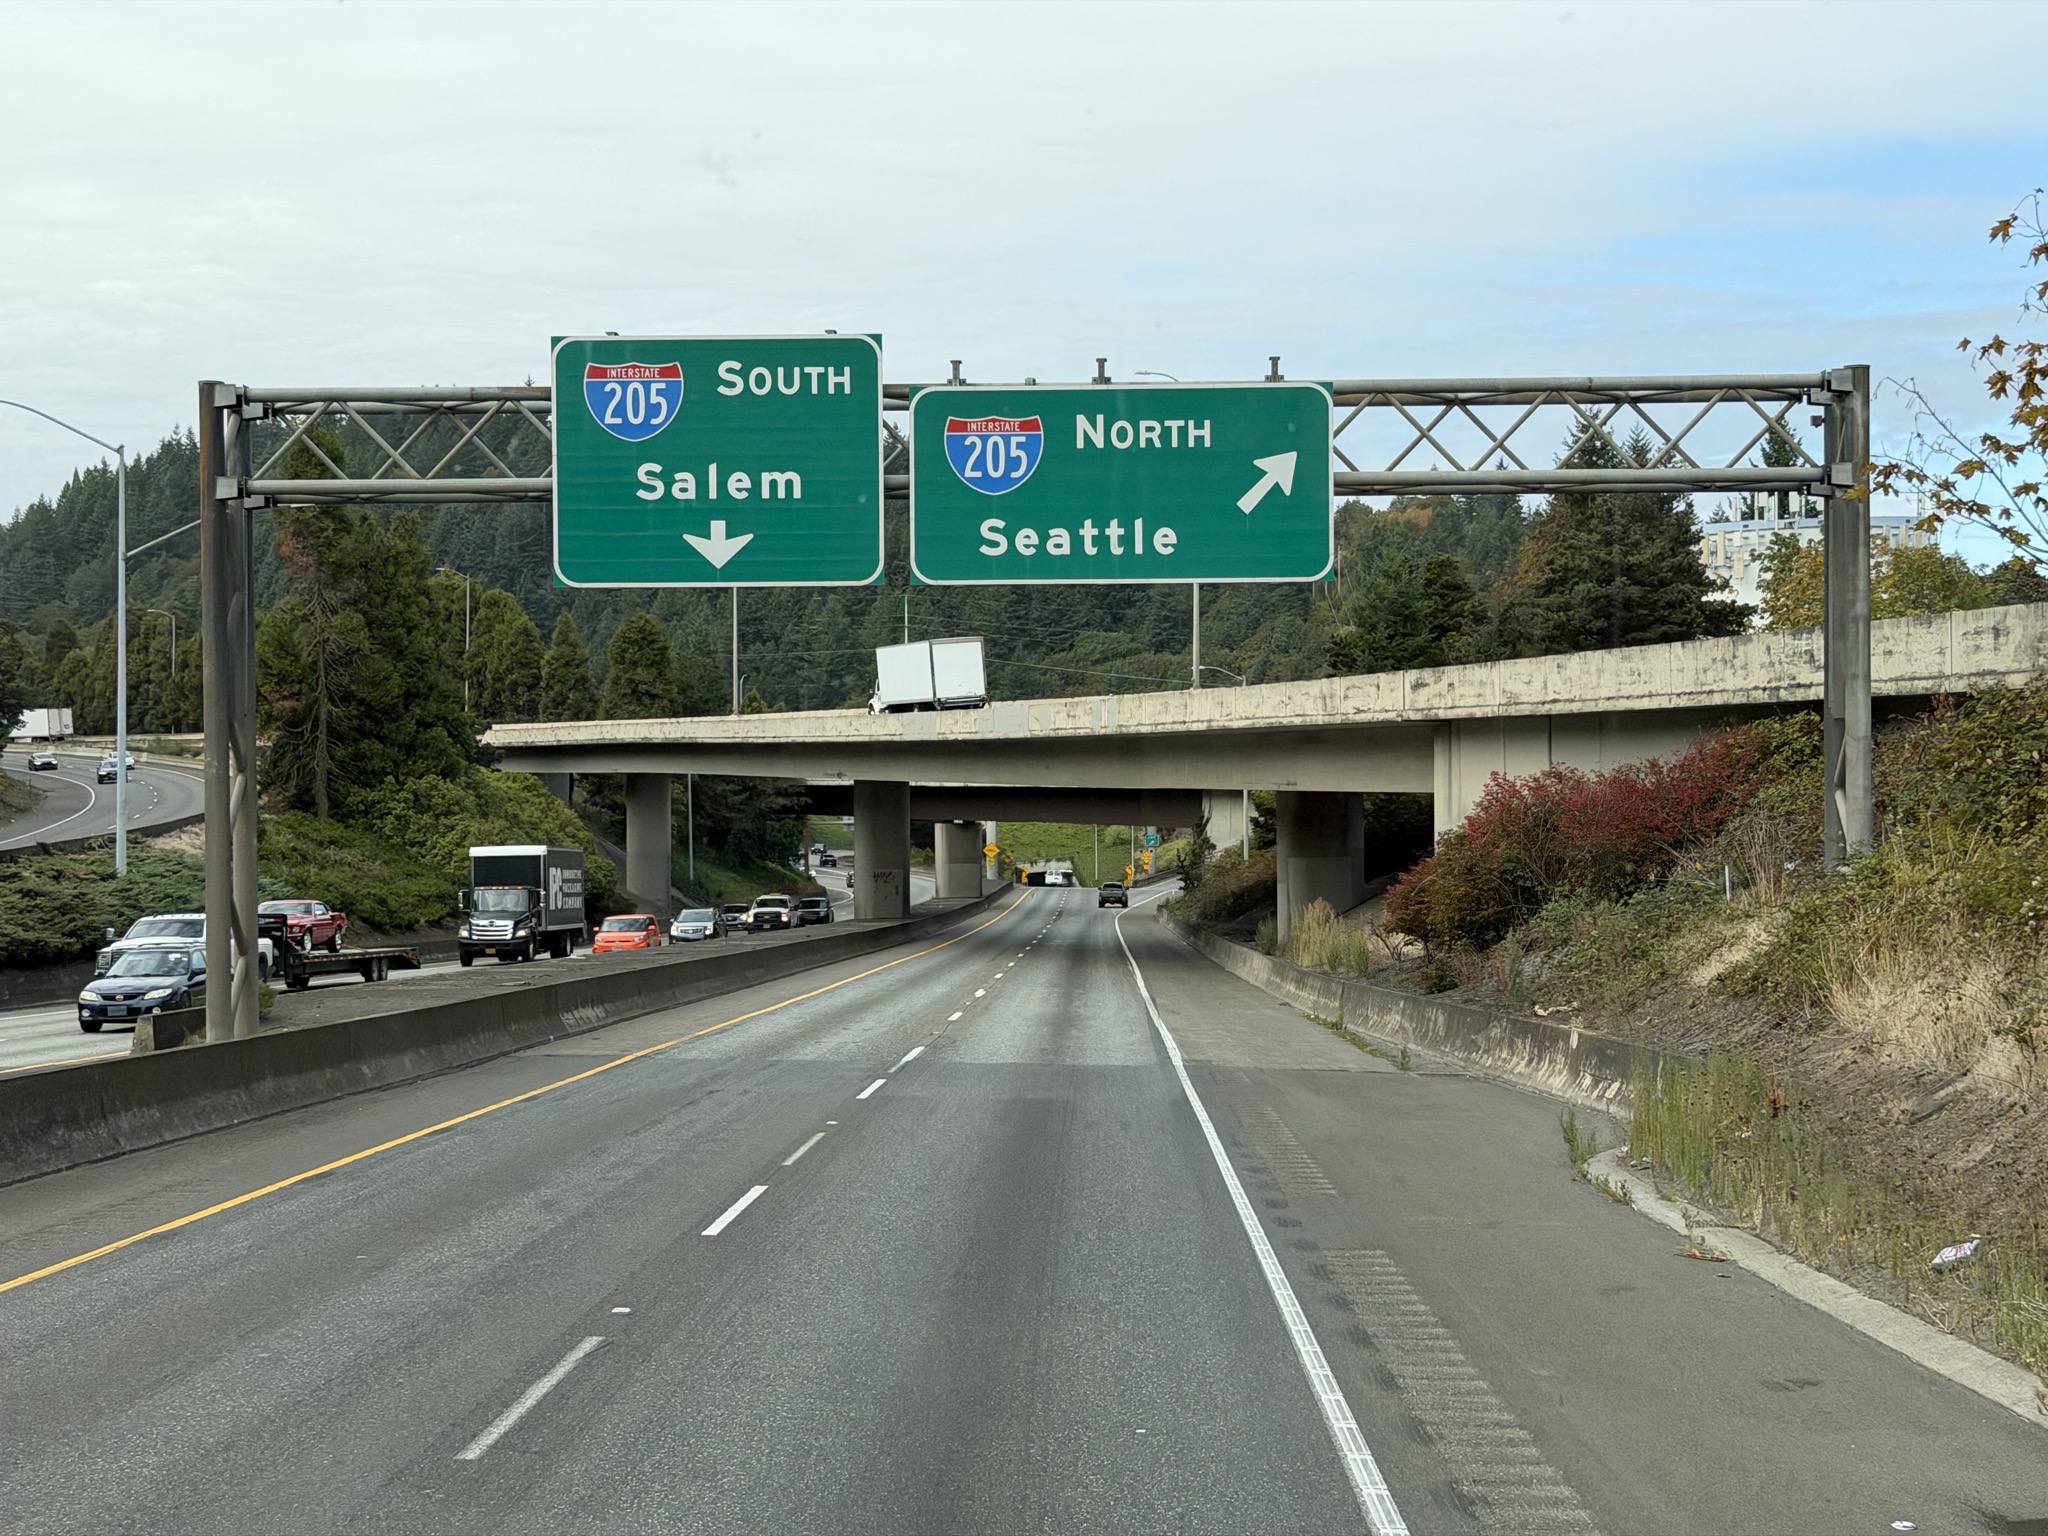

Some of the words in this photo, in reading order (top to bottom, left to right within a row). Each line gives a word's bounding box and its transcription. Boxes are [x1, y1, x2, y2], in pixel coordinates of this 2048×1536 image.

[606, 368, 660, 379] INTERSTATE
[717, 361, 850, 396] SOUTH
[604, 382, 668, 425] 205
[967, 420, 1021, 432] INTERSTATE
[1076, 414, 1211, 449] NORTH
[963, 435, 1028, 479] 205
[636, 463, 801, 501] Salem
[979, 517, 1178, 556] Seattle
